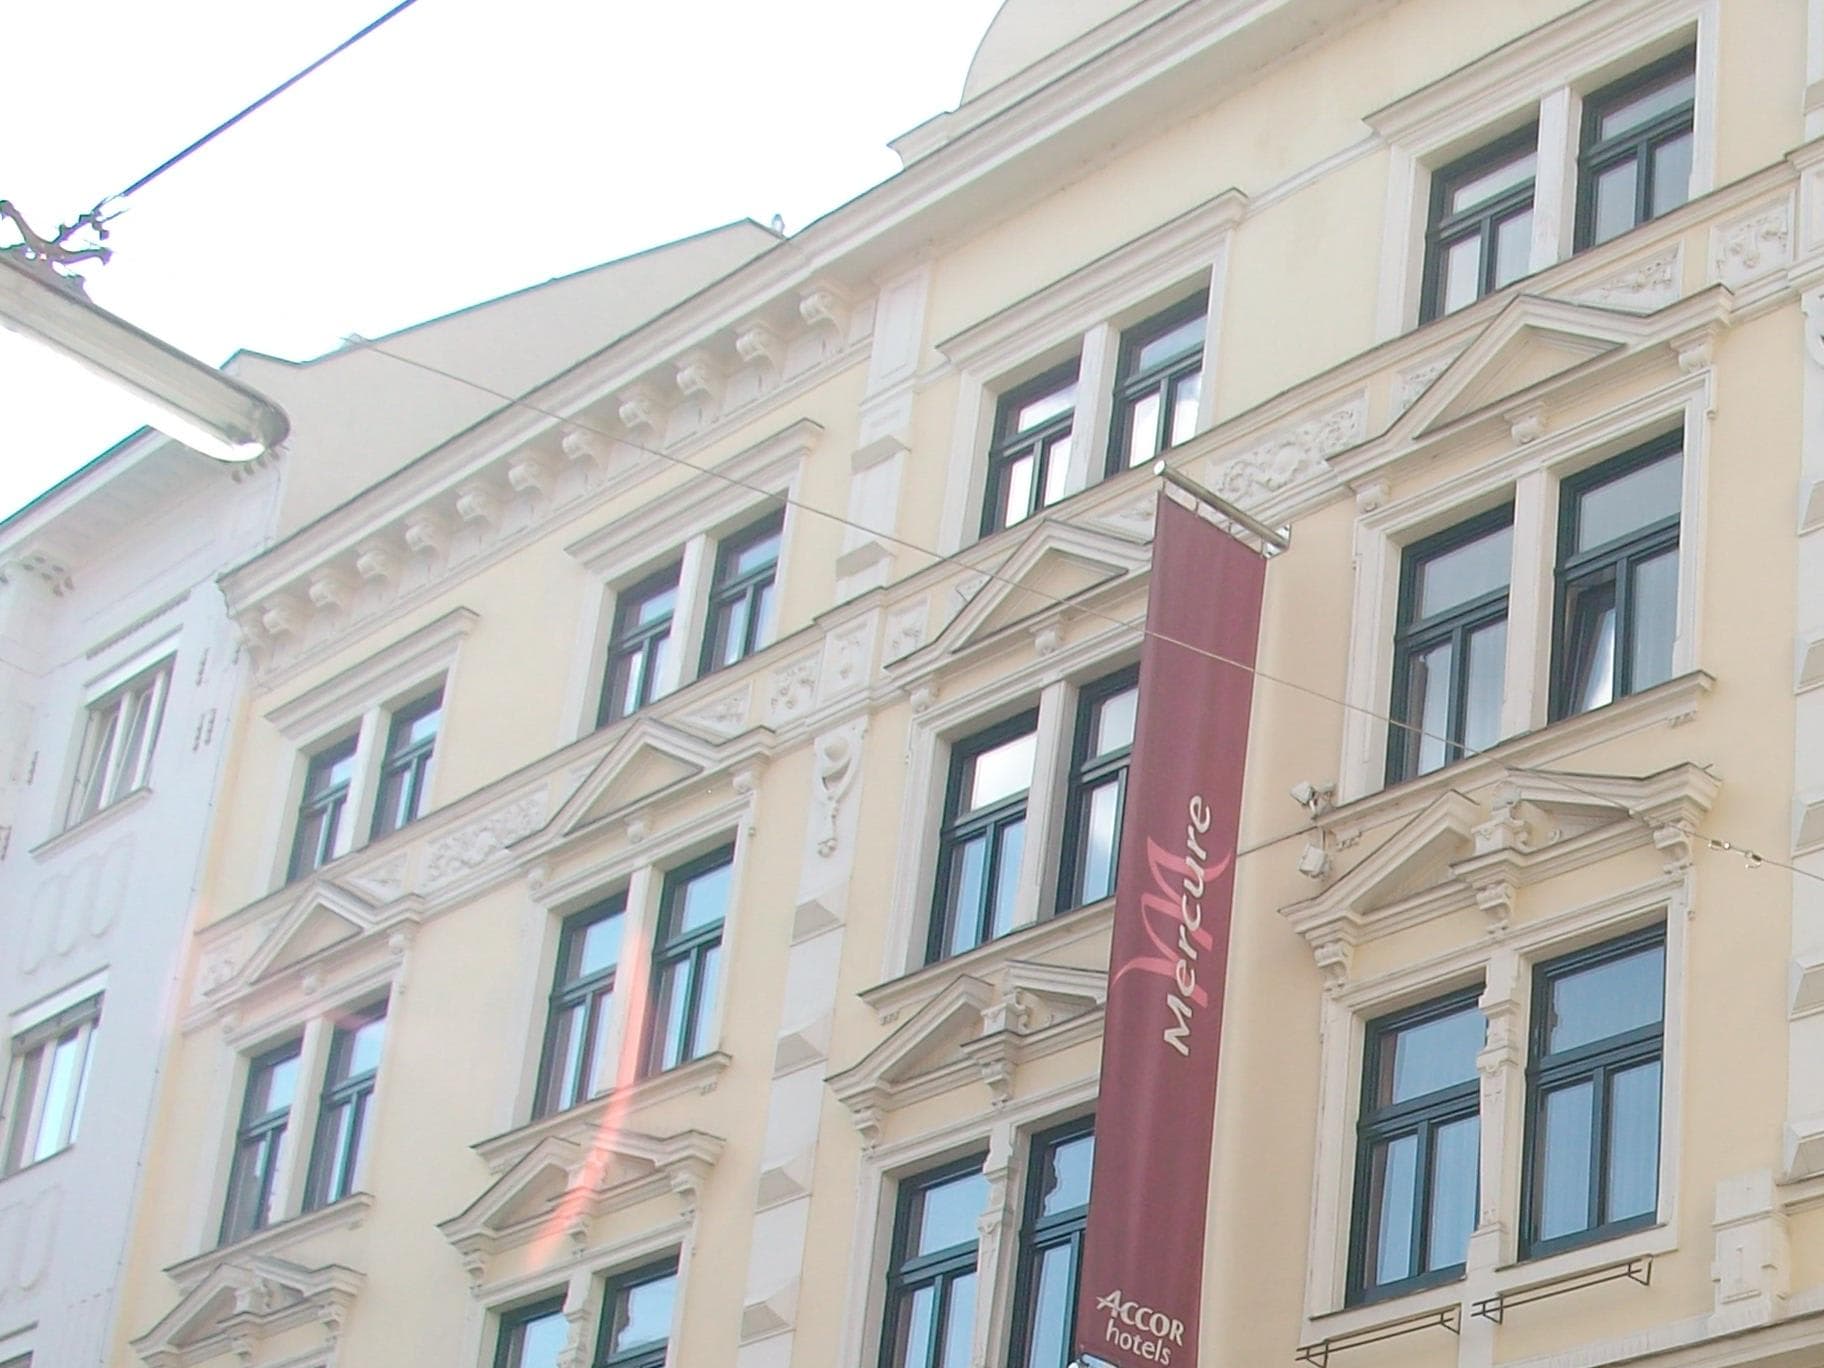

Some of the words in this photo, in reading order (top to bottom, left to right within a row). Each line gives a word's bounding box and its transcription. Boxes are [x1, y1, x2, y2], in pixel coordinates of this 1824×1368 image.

[1163, 794, 1211, 1057] Mercure
[1096, 1289, 1185, 1347] ACCOR
[1105, 1318, 1172, 1366] hotels
